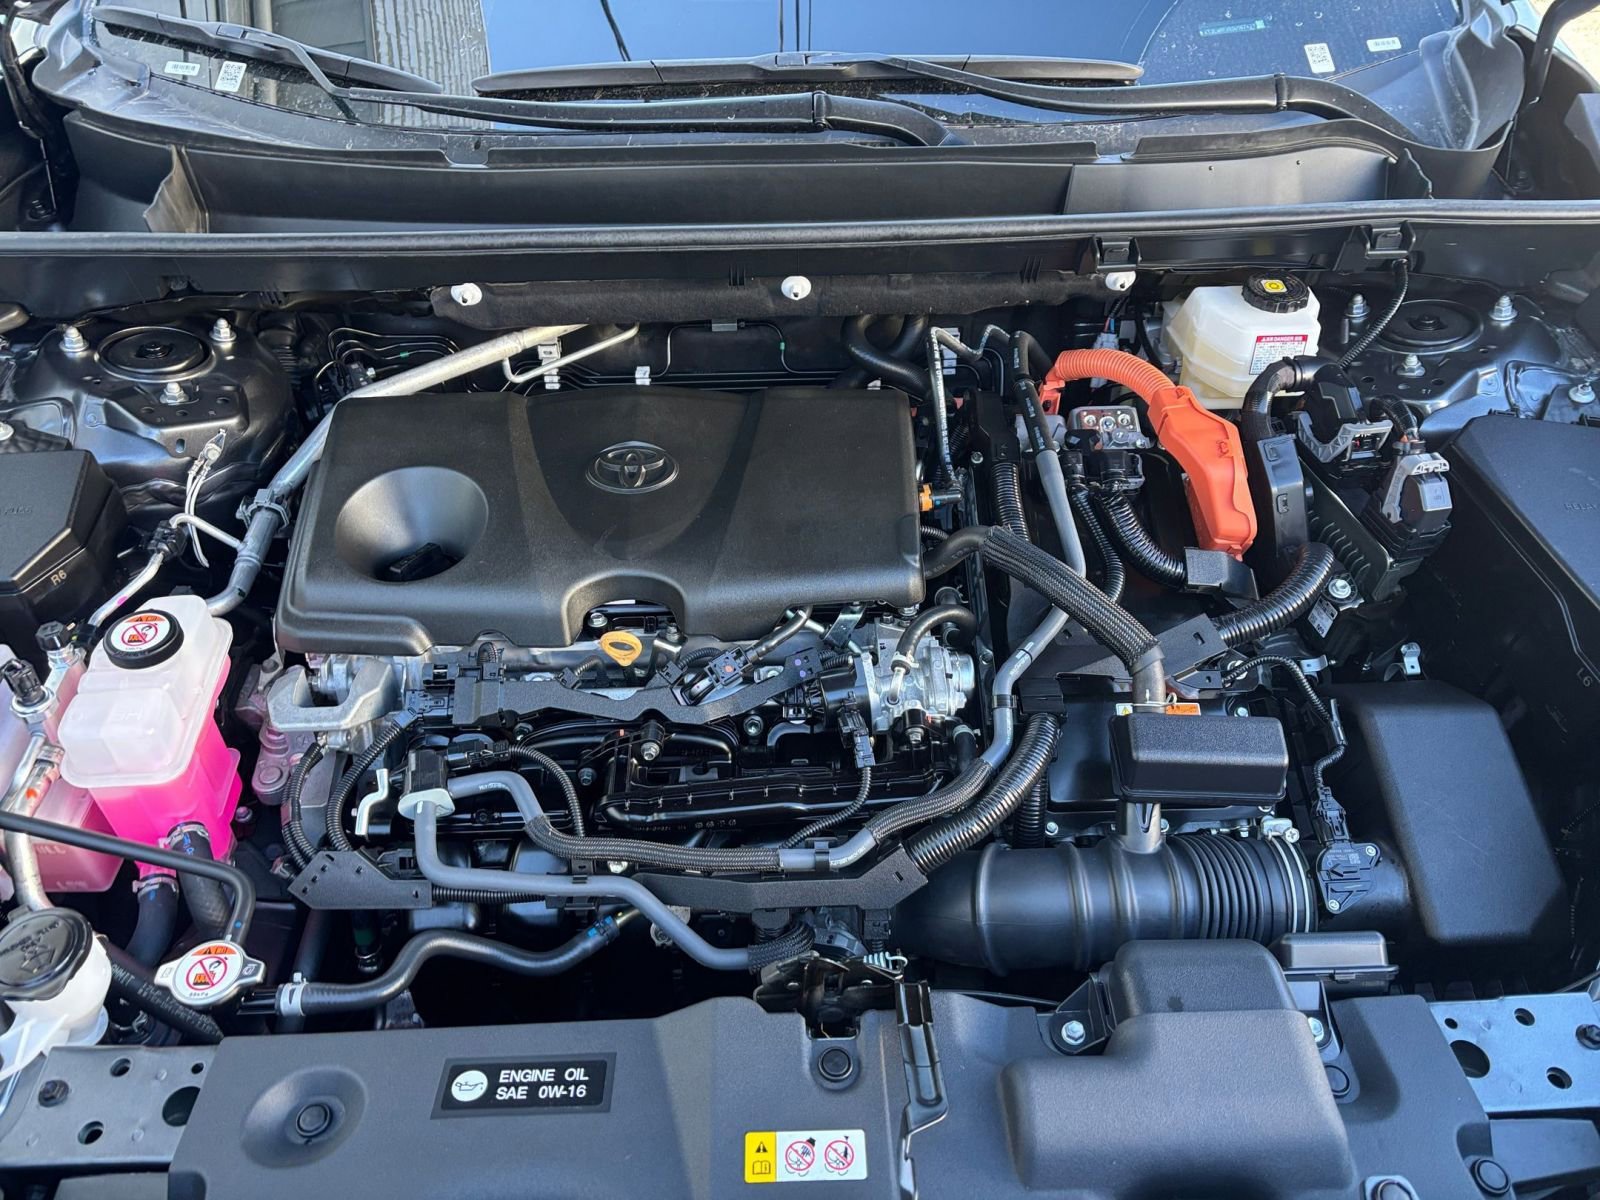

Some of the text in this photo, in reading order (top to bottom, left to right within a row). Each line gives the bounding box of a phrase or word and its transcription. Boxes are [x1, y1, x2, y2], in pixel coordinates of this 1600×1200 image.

[50, 569, 67, 586] R6
[1576, 667, 1593, 687] L6
[499, 1068, 589, 1083] ENGINE OIL
[495, 1085, 587, 1100] SAE 0W-16
